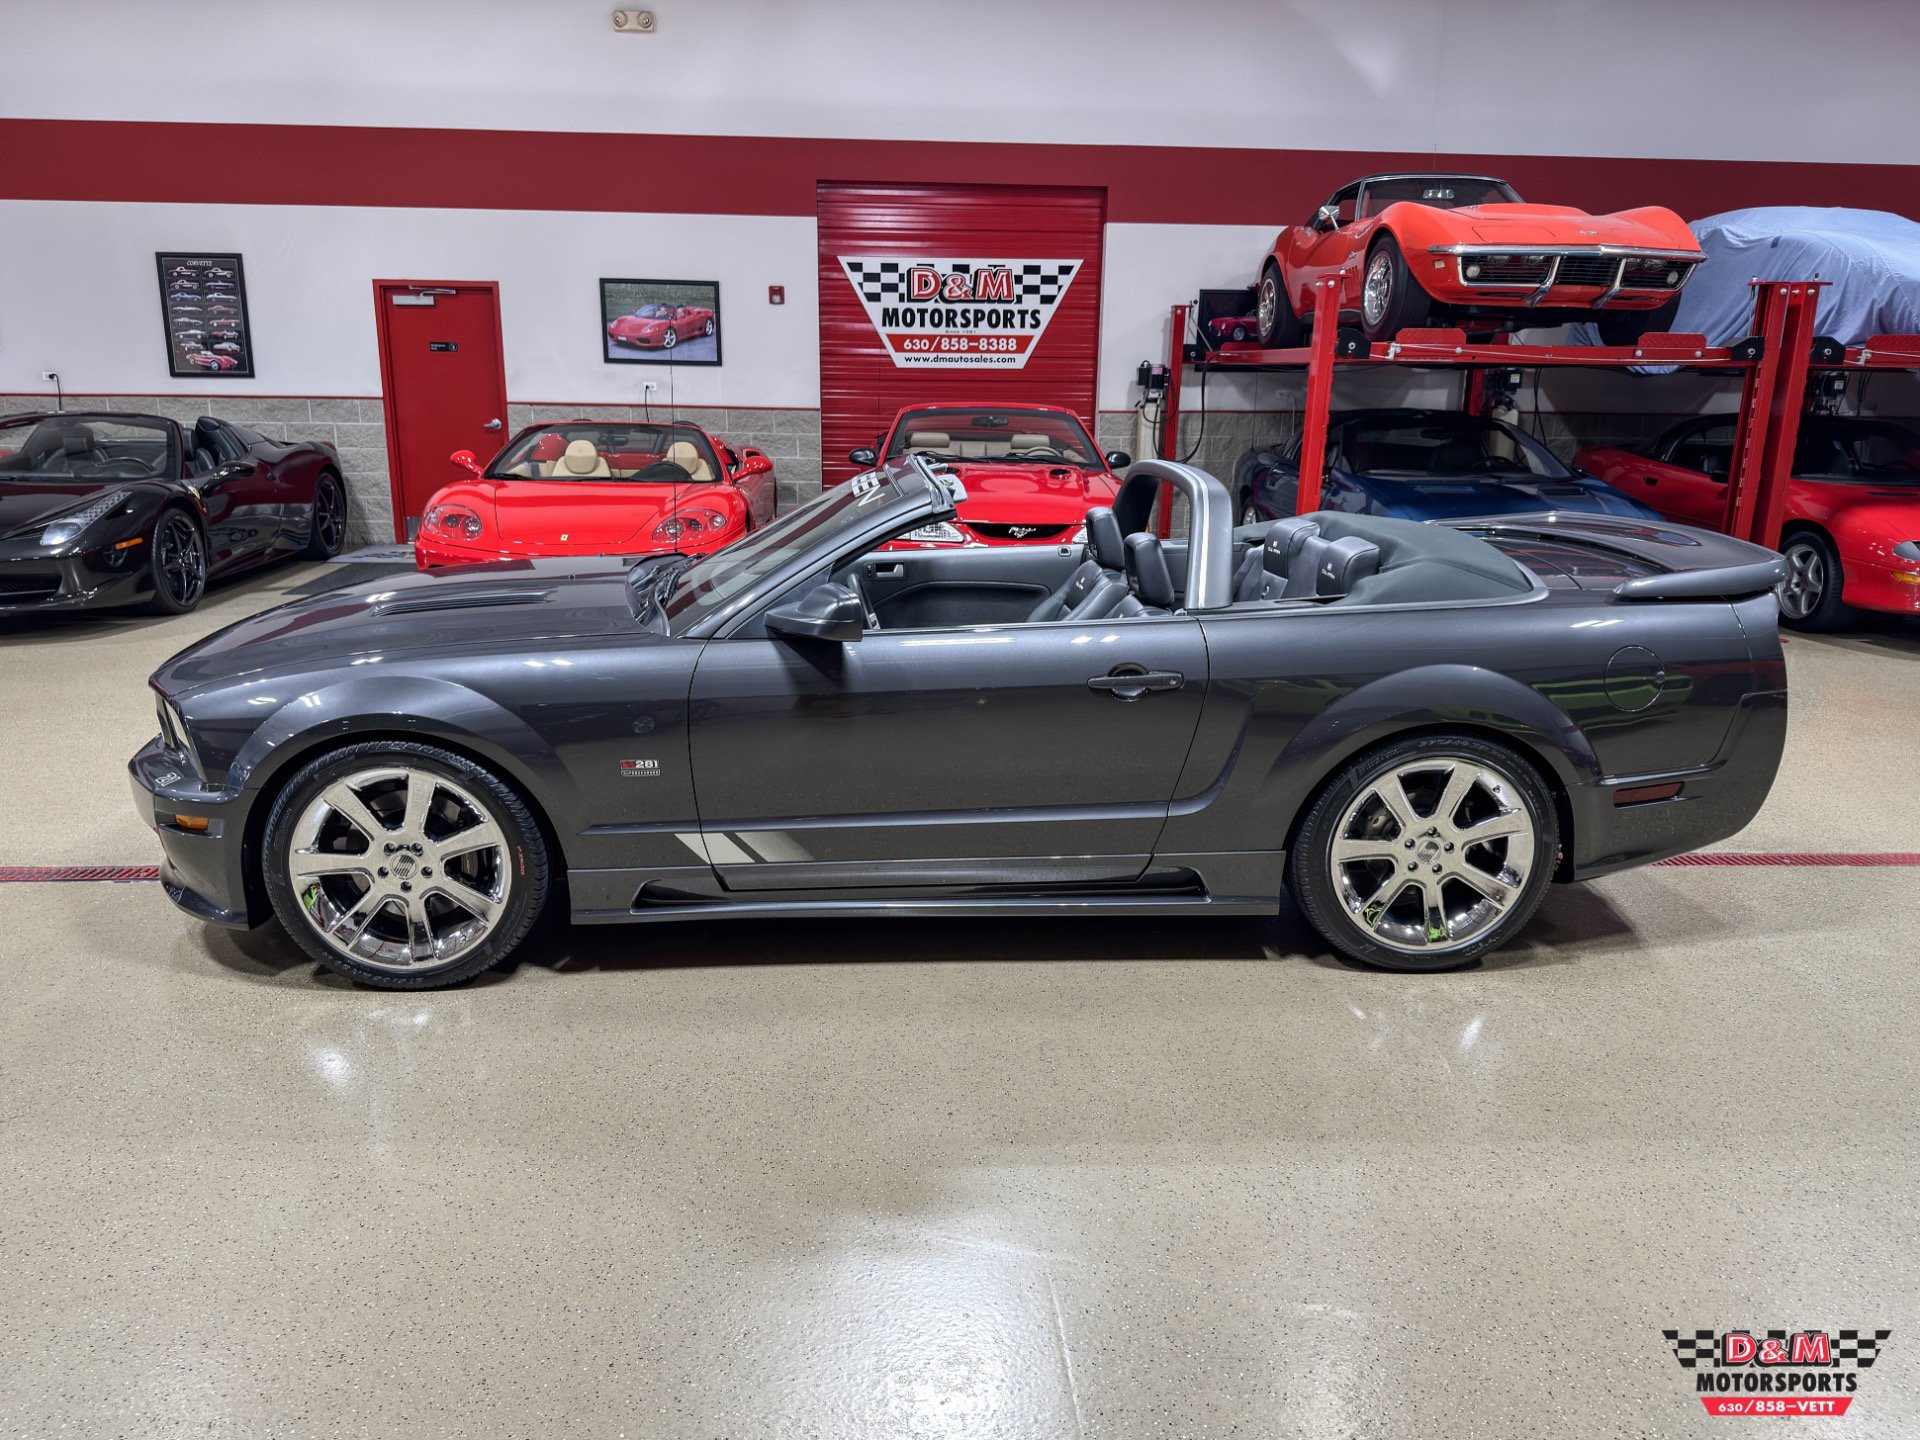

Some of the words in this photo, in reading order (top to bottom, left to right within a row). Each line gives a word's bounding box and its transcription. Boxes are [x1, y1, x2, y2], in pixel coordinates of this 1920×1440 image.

[909, 267, 1015, 303] D&M
[881, 307, 1041, 329] MOTORSPORTS
[903, 336, 1017, 353] 630/858-8388
[904, 354, 1016, 364] www.dmautosales.com
